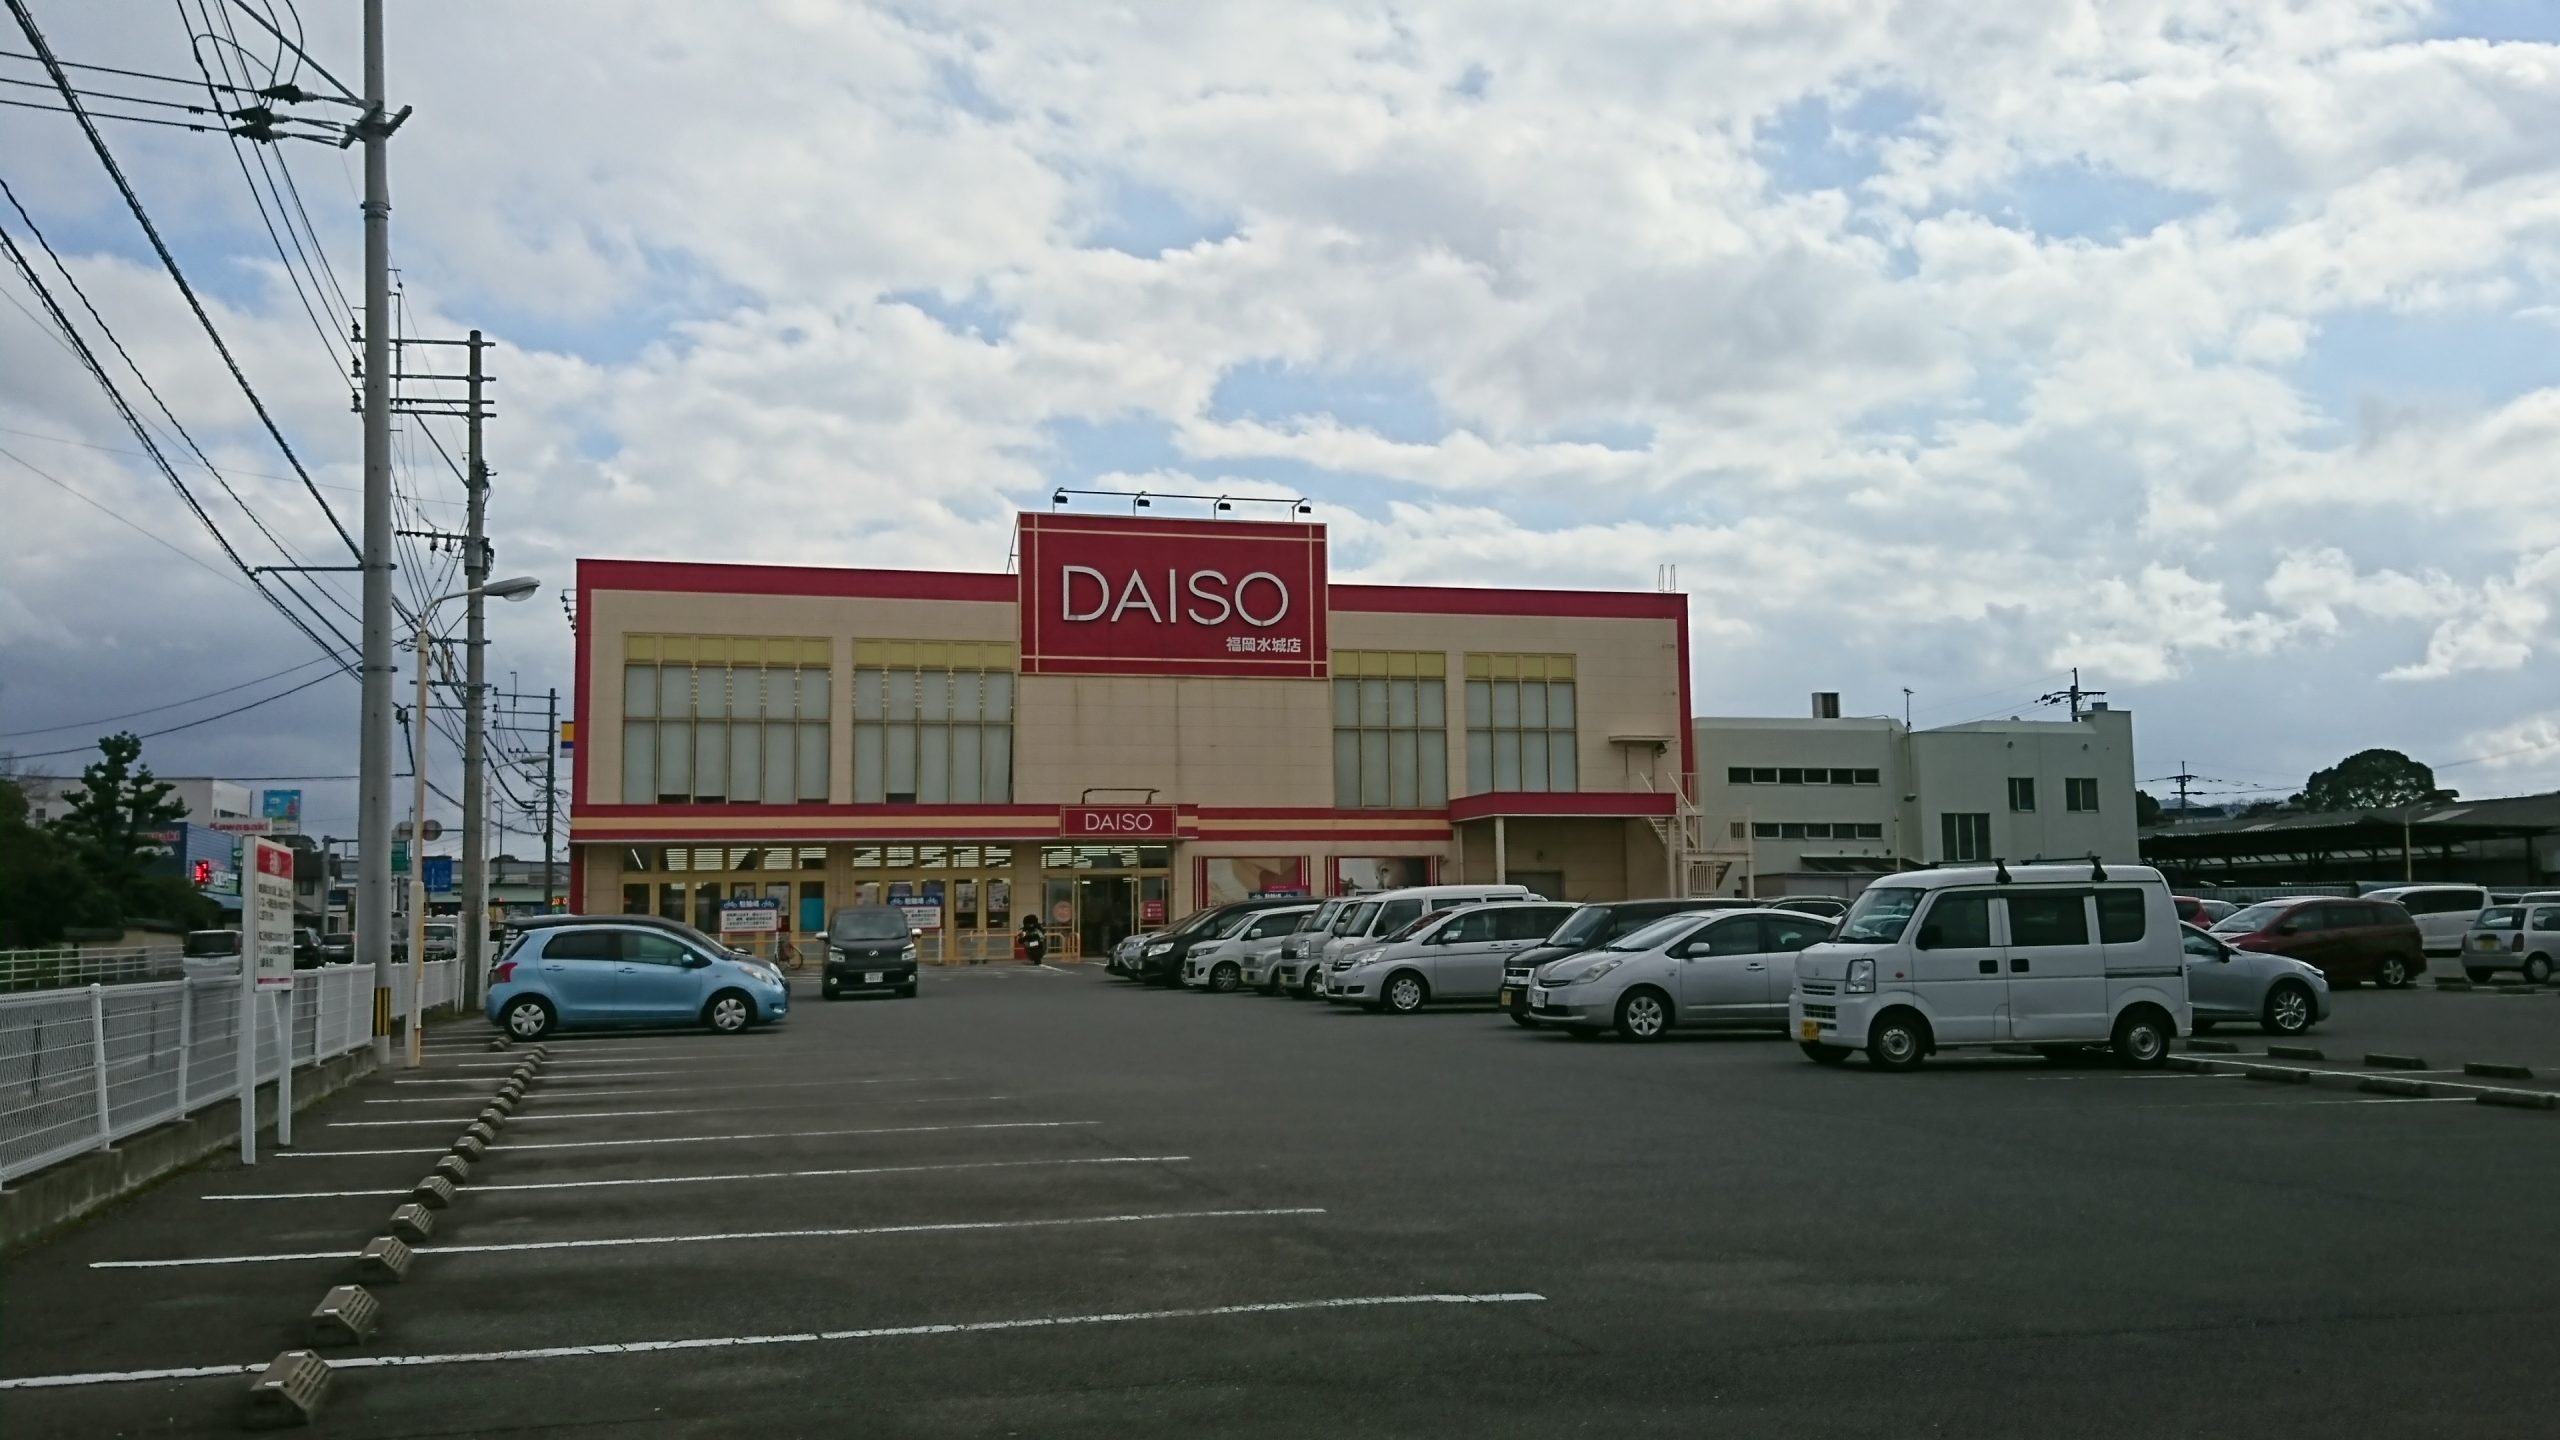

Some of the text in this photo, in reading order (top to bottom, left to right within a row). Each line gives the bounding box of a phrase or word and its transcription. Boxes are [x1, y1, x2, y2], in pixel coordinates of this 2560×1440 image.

[1063, 565, 1289, 627] DAISO
[1226, 636, 1301, 653] 福岡水城店
[209, 821, 269, 832] Kawasaki
[1085, 813, 1153, 831] DAISO
